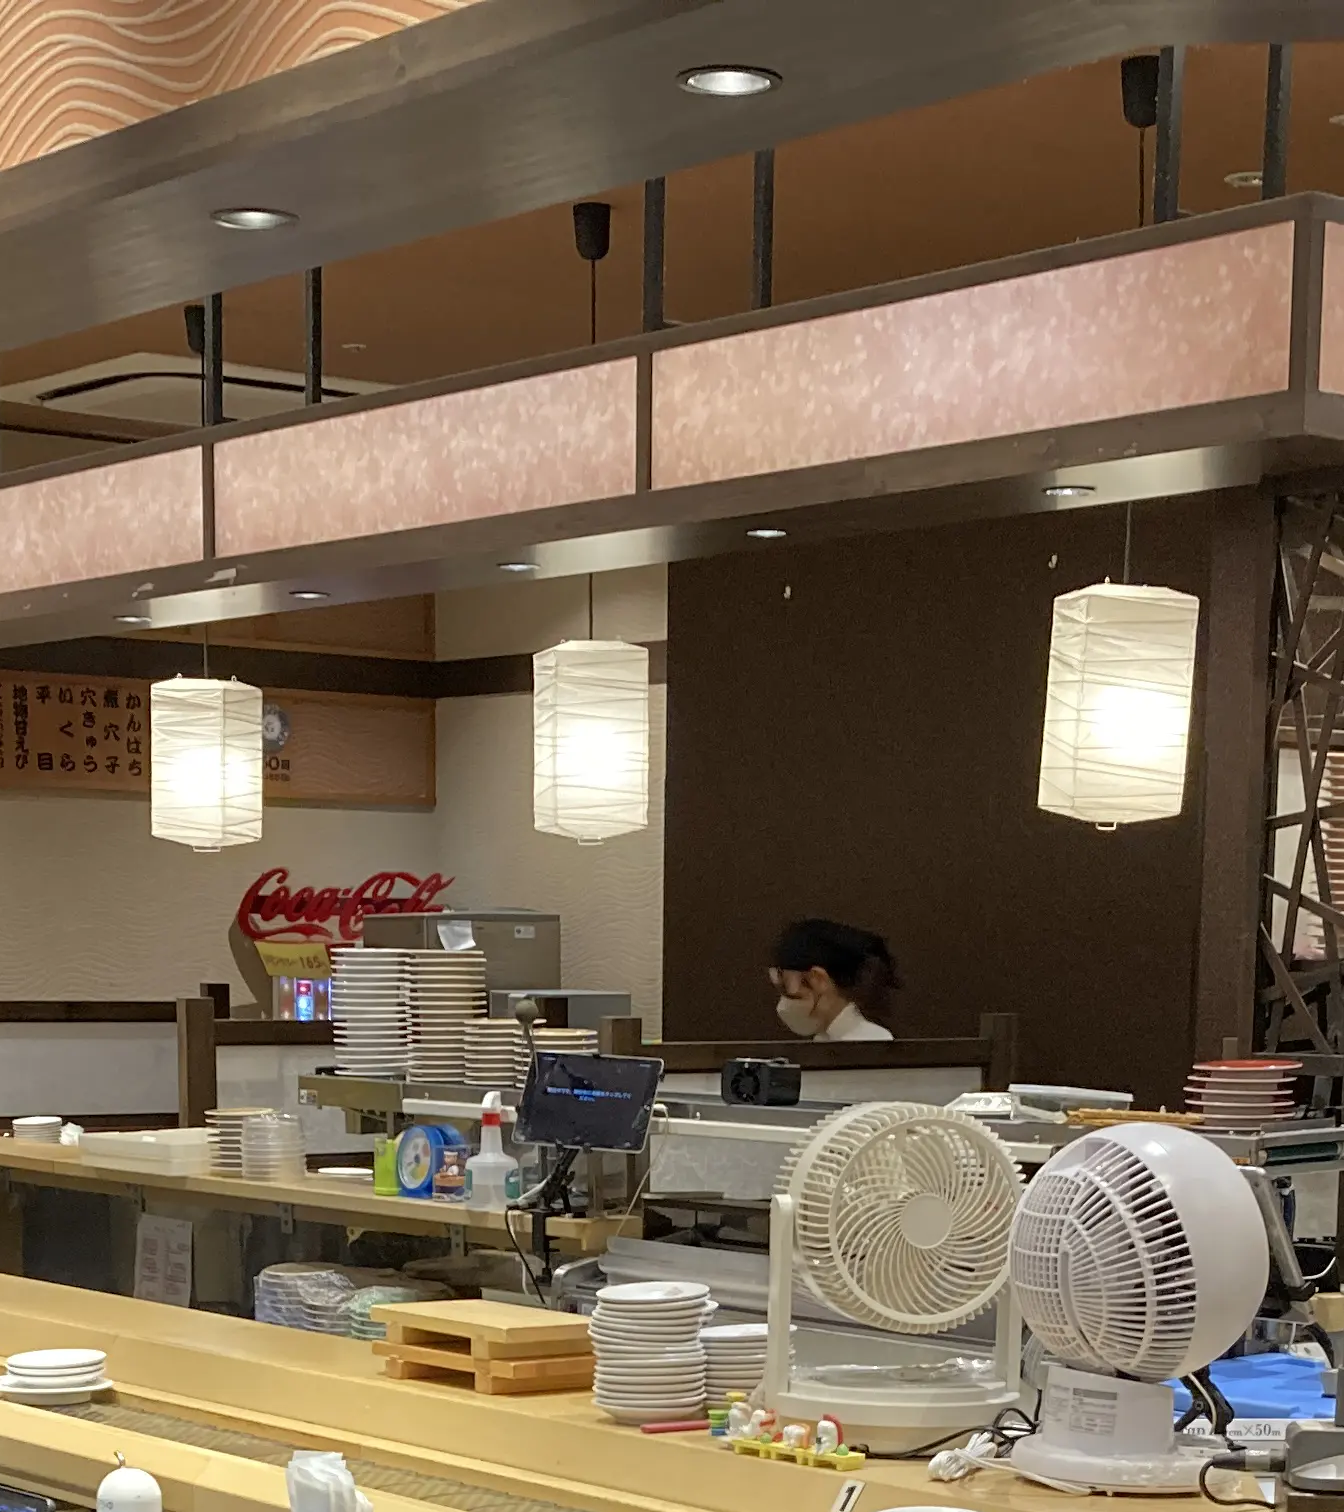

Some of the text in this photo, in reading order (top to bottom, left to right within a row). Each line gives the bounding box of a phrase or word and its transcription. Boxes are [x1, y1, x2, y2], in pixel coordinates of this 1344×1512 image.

[36, 685, 53, 771] 平目
[58, 687, 76, 773] いくら
[237, 867, 456, 941] Coca-Cl
[839, 1485, 857, 1512] 1
